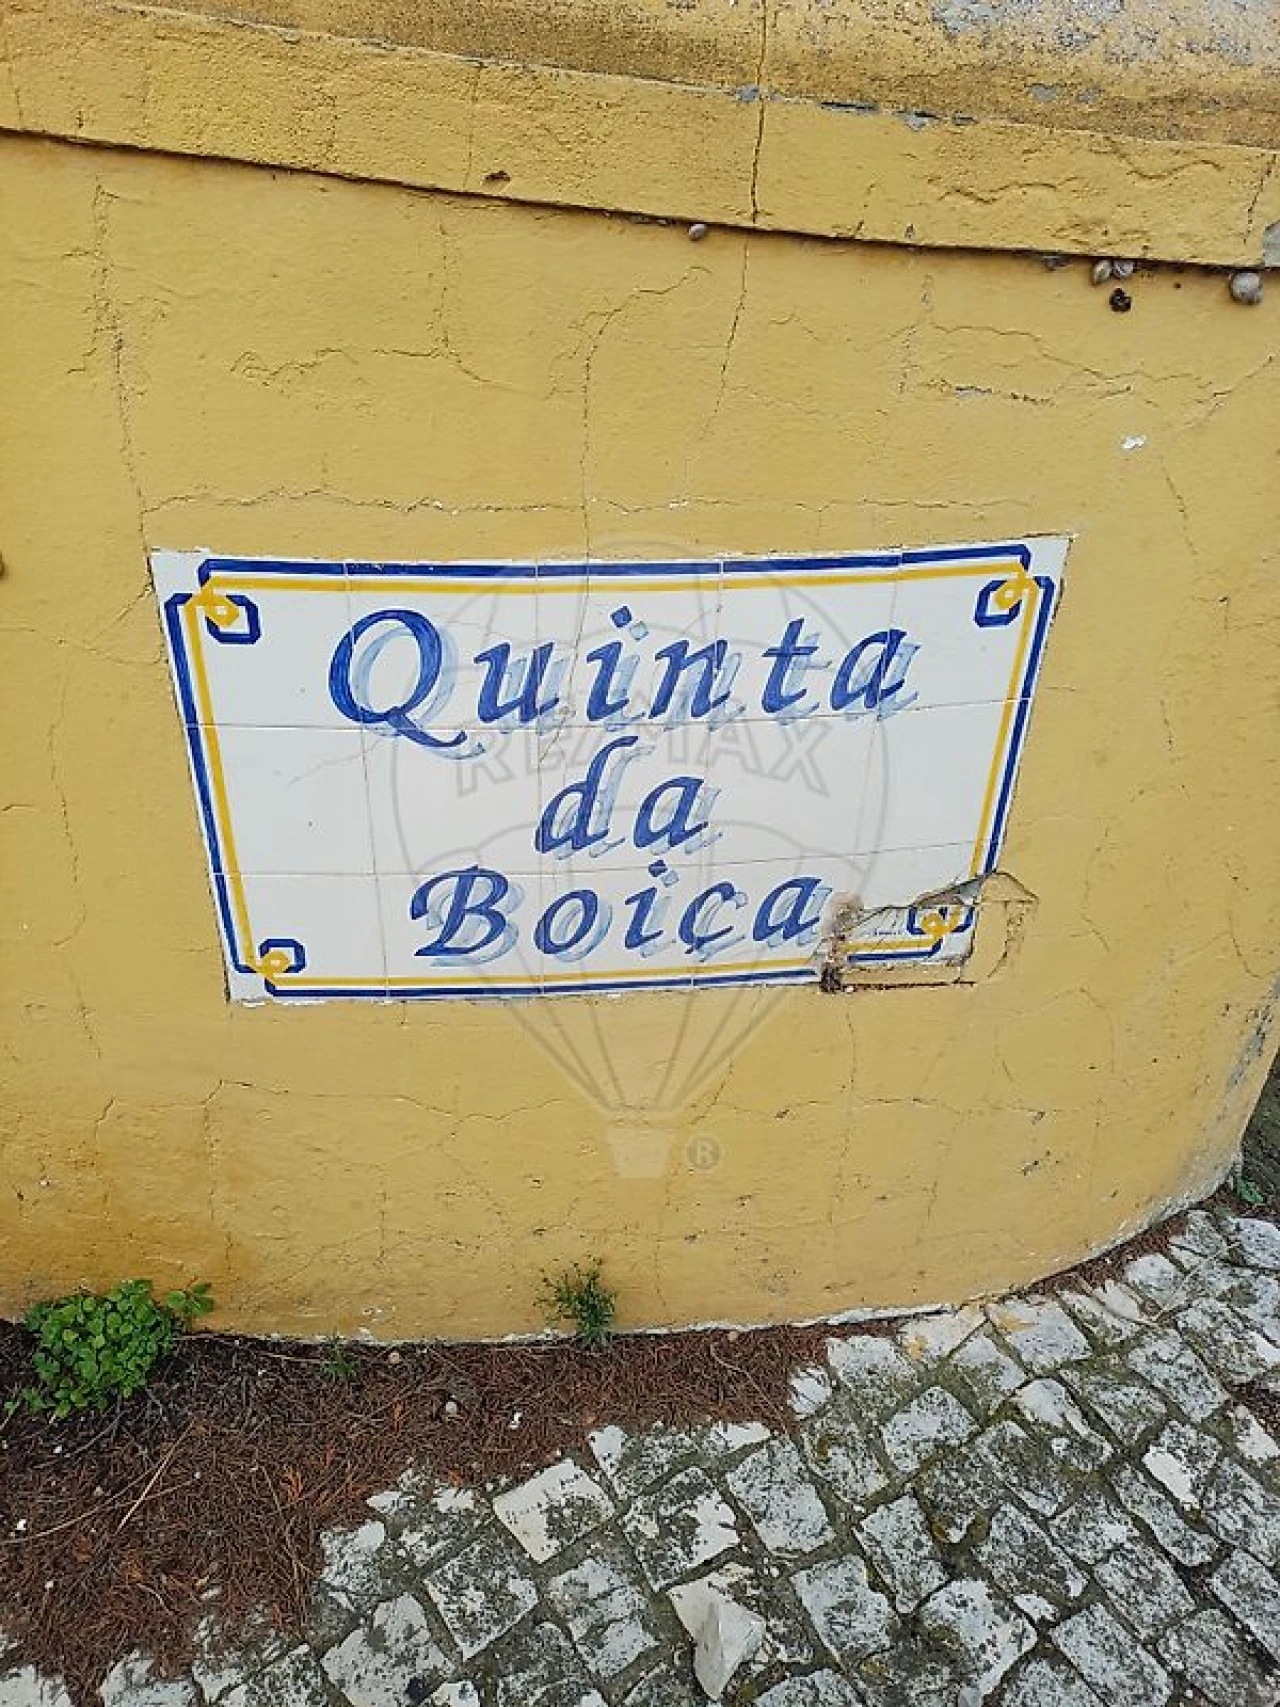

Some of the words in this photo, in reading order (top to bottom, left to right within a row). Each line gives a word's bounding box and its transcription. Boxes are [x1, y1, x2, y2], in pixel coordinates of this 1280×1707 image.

[329, 606, 908, 748] Quinta
[535, 735, 709, 854] da
[410, 859, 822, 957] Boiça
